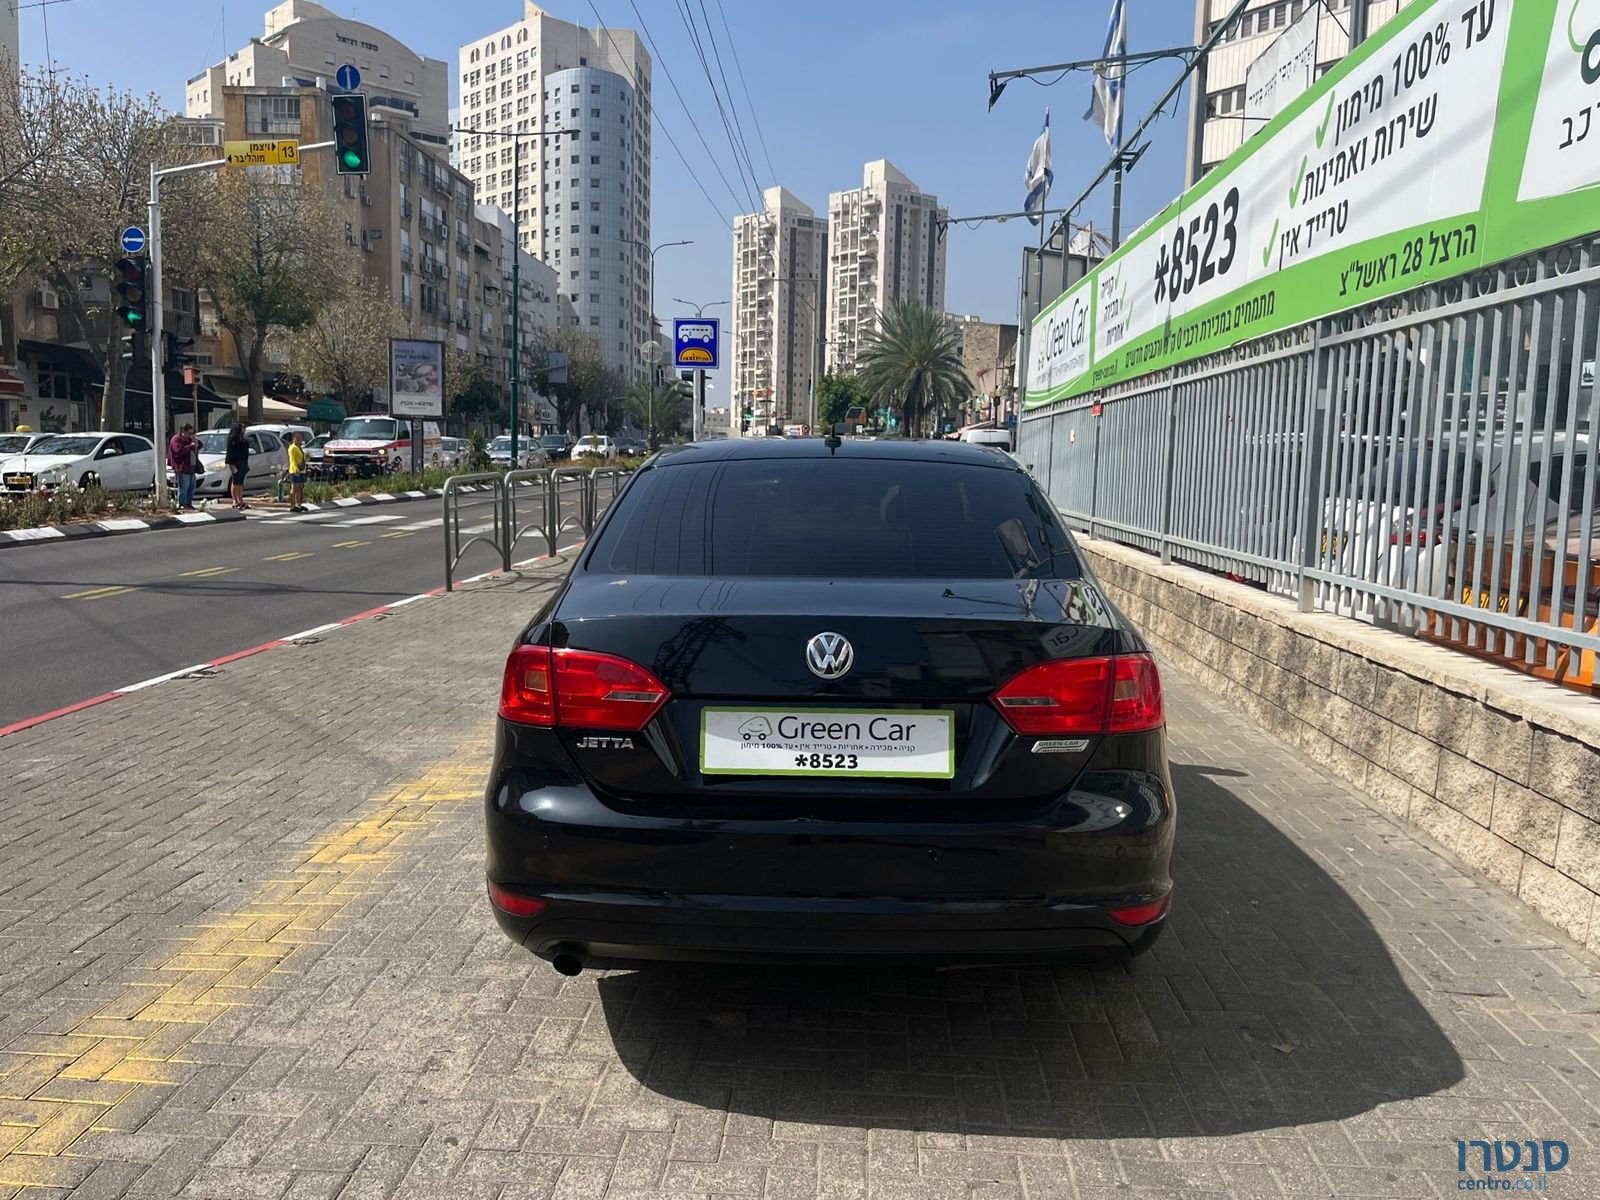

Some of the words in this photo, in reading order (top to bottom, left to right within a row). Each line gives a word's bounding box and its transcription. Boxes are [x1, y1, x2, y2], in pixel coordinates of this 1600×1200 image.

[1460, 0, 1496, 50] עד
[1392, 21, 1451, 98] 100%
[1334, 74, 1385, 147] מימון
[1371, 92, 1439, 166] שירות
[233, 152, 266, 163] מוהליבר
[249, 143, 271, 154] ויצמן
[281, 145, 295, 159] 13
[1302, 136, 1369, 206] ואמינות
[1306, 199, 1350, 248] טרייד
[1279, 224, 1302, 272] אין
[1400, 237, 1424, 276] 28
[1428, 223, 1478, 267] הרצל
[1046, 317, 1070, 362] Green
[1070, 298, 1089, 348] Car
[1199, 309, 1232, 342] במכירת
[1234, 290, 1276, 329] מתמחים
[1183, 324, 1199, 348] רכבי
[576, 737, 635, 750] JETTA
[778, 716, 861, 741] Green
[868, 717, 916, 742] Car
